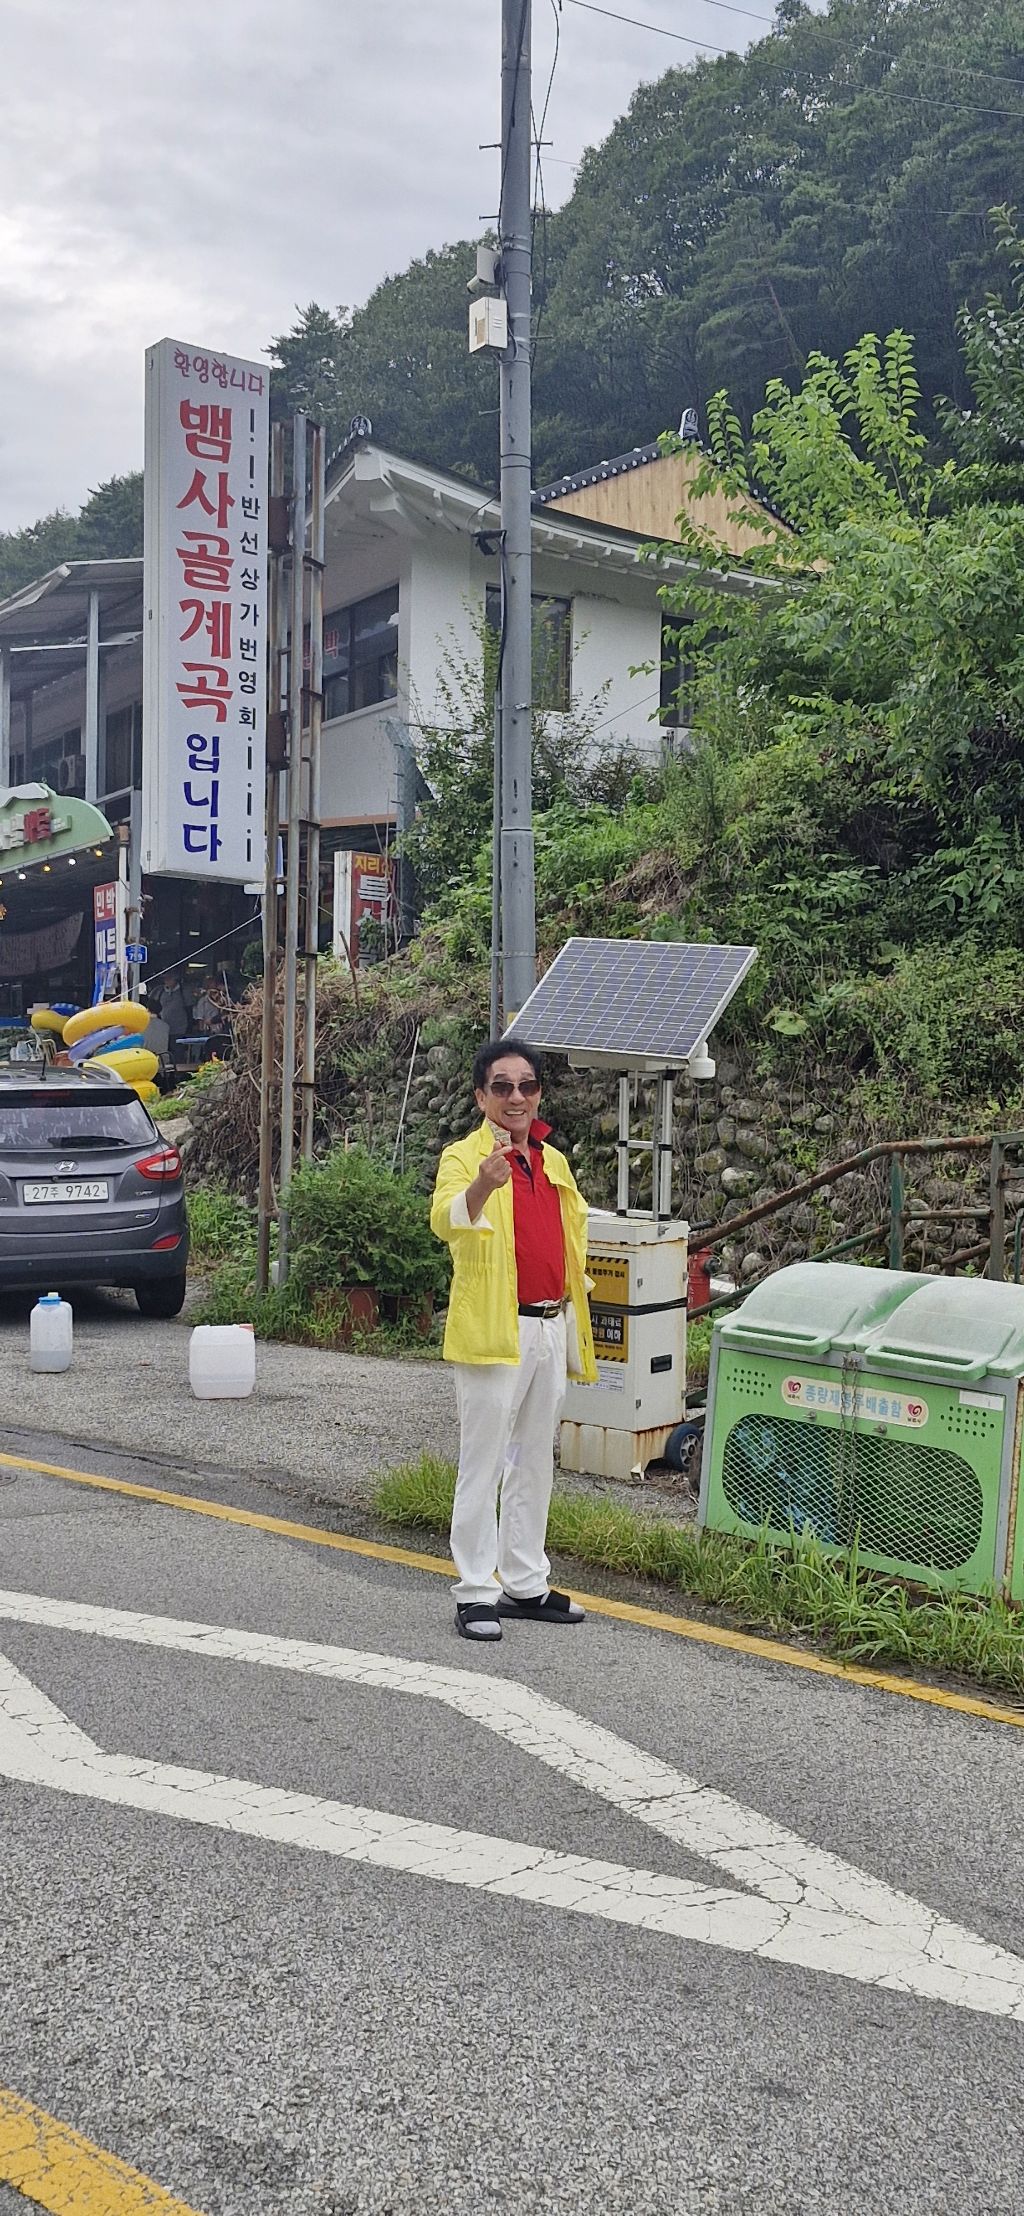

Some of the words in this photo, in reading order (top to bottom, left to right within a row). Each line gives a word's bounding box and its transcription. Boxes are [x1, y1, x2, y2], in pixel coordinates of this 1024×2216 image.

[173, 348, 265, 396] 환영합니다
[96, 886, 116, 918] 민박
[32, 1186, 60, 1200] 27주
[65, 1184, 100, 1198] 9742
